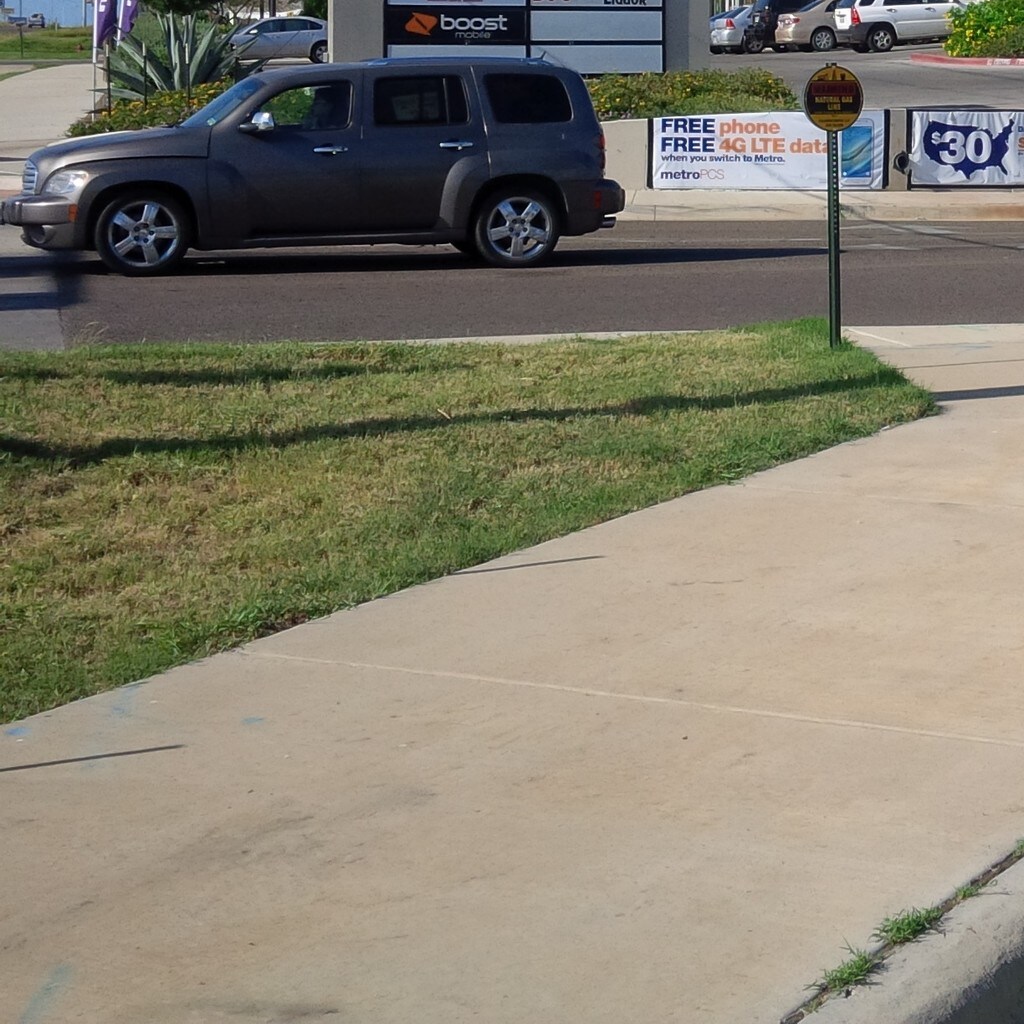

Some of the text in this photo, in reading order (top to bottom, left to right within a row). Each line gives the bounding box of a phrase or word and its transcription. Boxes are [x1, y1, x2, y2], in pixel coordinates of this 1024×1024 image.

[440, 14, 507, 31] boost
[454, 31, 491, 39] mobile
[661, 118, 780, 137] FREE phone
[660, 137, 715, 153] FREE
[719, 137, 746, 153] 4G
[751, 137, 785, 153] LTE
[931, 130, 992, 164] $30
[690, 155, 707, 164] you
[709, 154, 741, 163] switch
[743, 154, 752, 163] to
[660, 169, 725, 180] metroPCS
